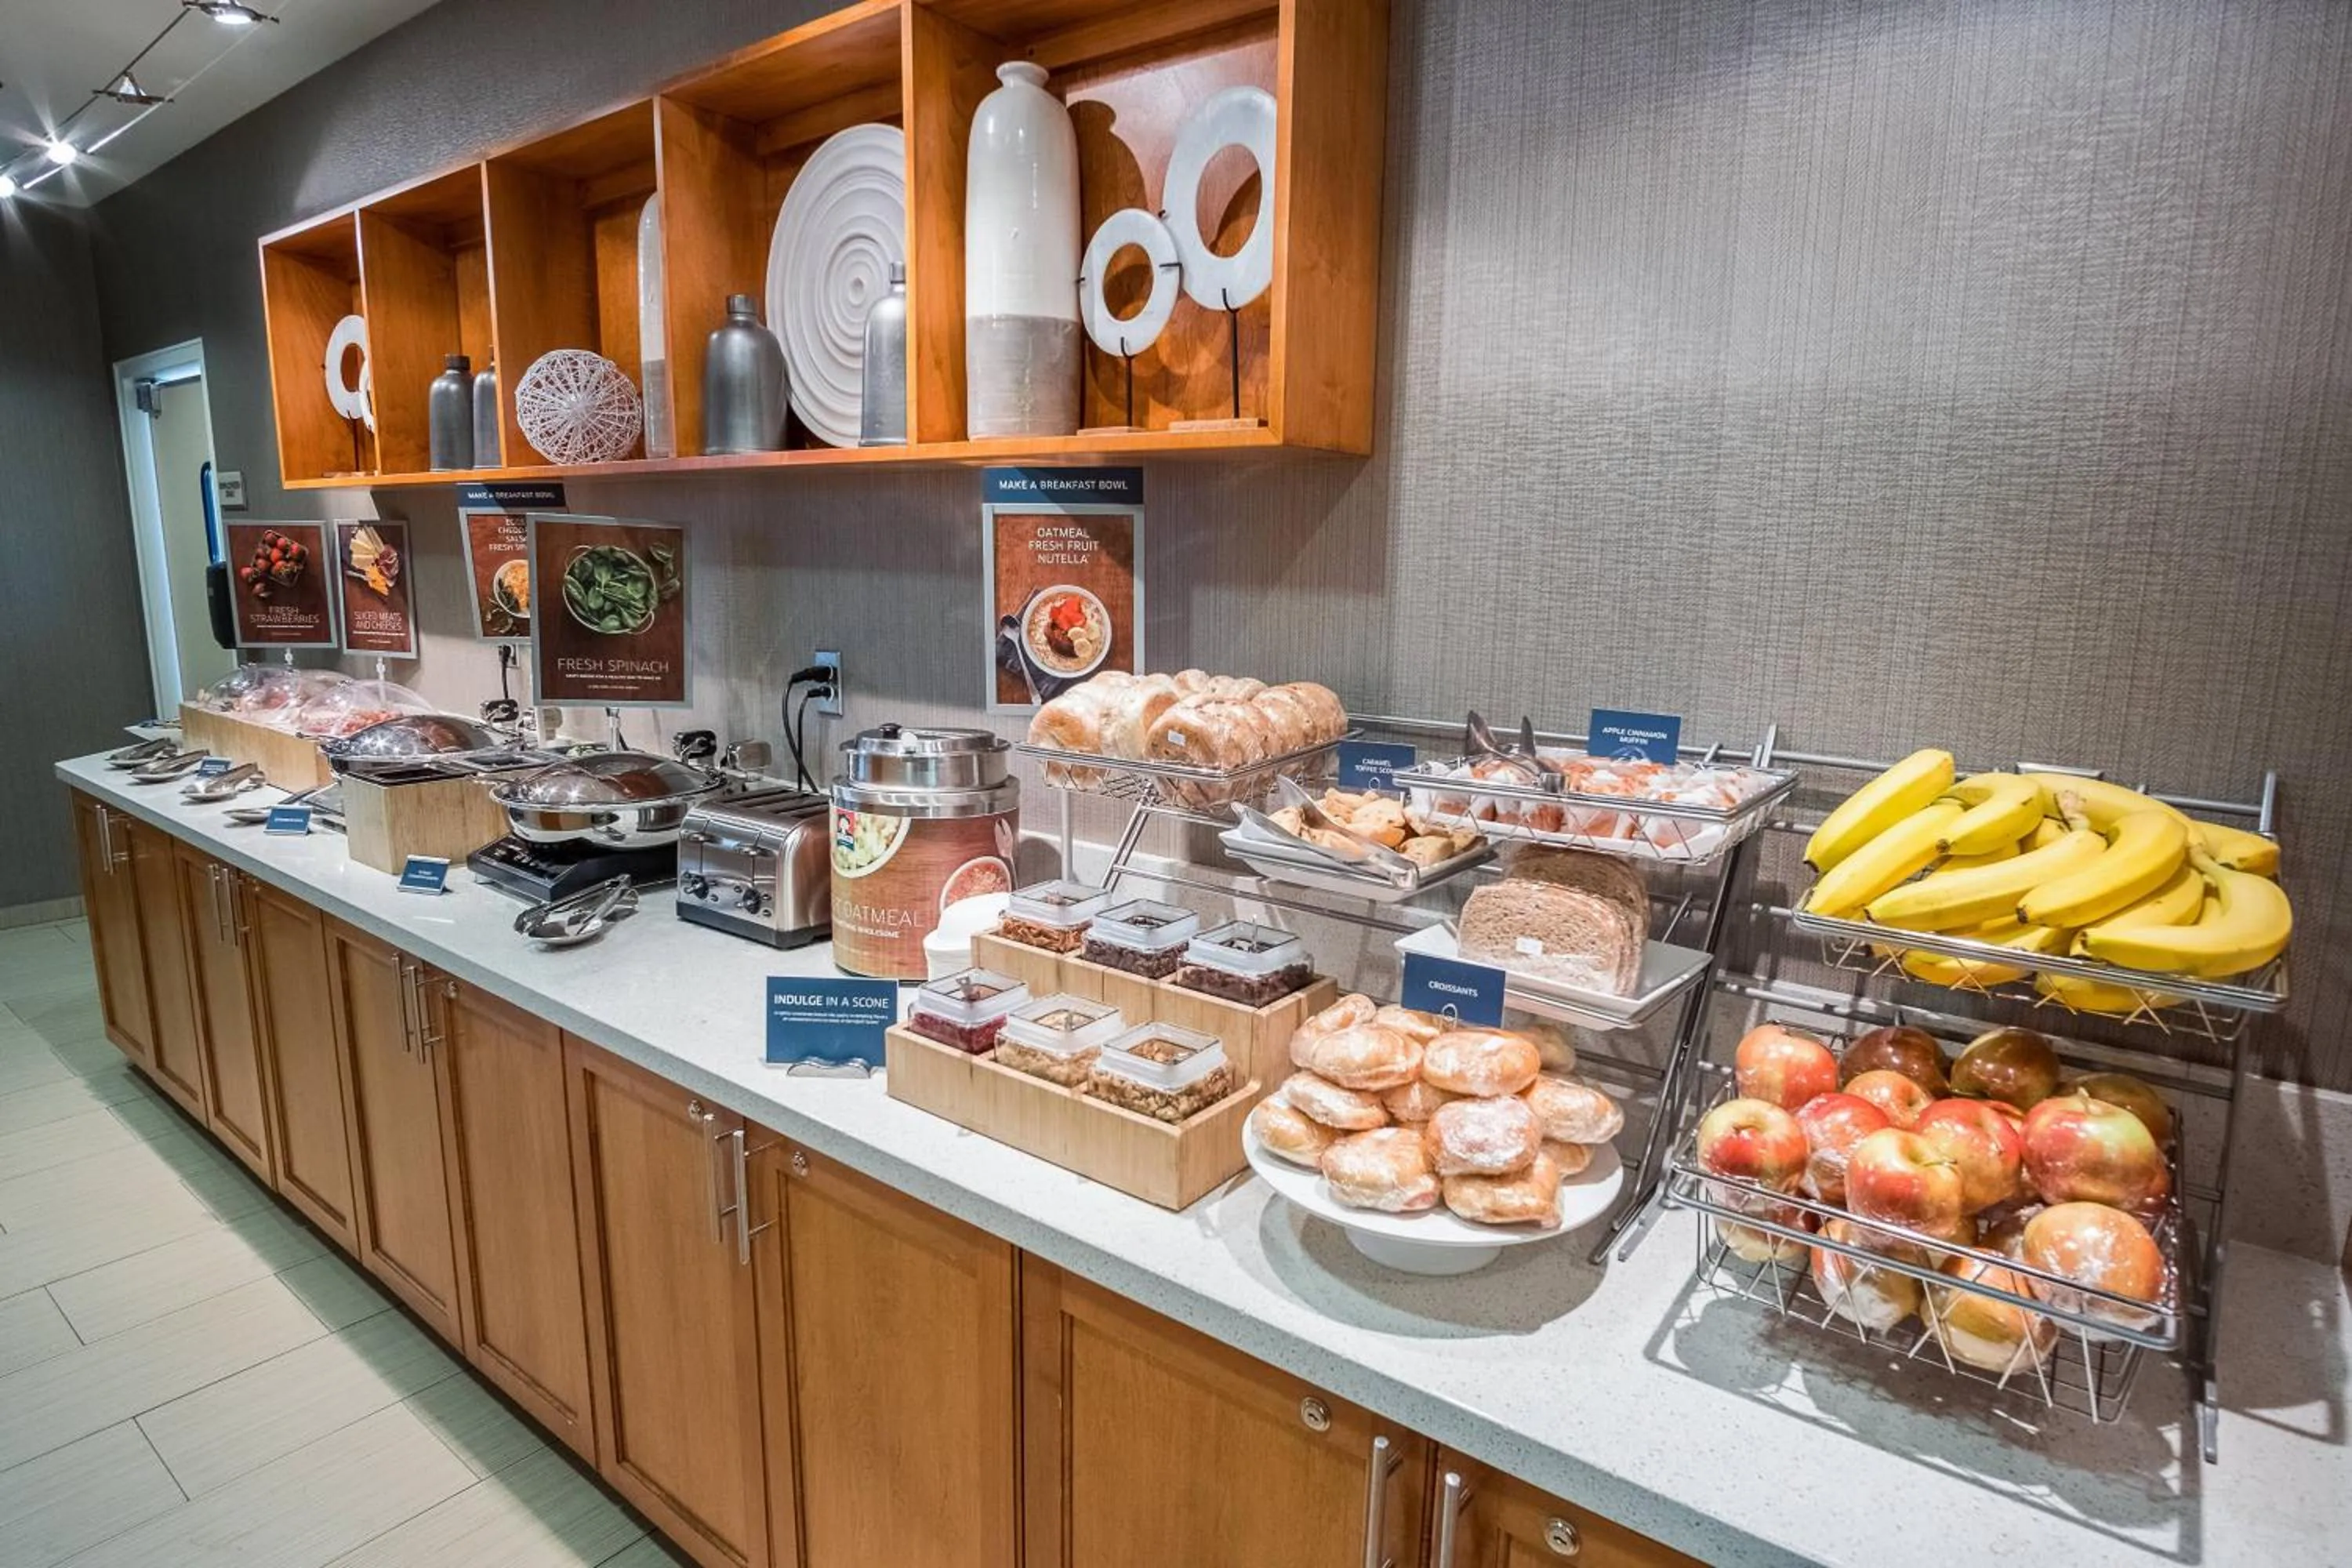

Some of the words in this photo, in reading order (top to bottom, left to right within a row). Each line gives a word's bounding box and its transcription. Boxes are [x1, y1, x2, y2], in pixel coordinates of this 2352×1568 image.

[999, 480, 1027, 490] MAKE
[1029, 481, 1037, 490] A
[1040, 480, 1096, 490] BREAKFAST
[1099, 481, 1128, 490] BOWL
[467, 491, 488, 499] MAKE
[1037, 528, 1090, 539] OATMEAL
[1029, 541, 1064, 551] FRESH
[1067, 541, 1099, 551] FRUIT
[269, 606, 299, 615] FRESH
[250, 614, 321, 623] STRAWBERRIES
[379, 612, 402, 622] MEATS
[557, 658, 603, 672] FRESH
[608, 659, 670, 673] SPINACH
[1627, 728, 1668, 740] CINNAMON
[1619, 736, 1649, 746] MUFFIN
[843, 901, 926, 928] OATMEAL
[1428, 980, 1478, 998] CROISSANTS
[774, 994, 822, 1006] INDULGE
[826, 996, 838, 1007] IN
[841, 997, 849, 1007] A
[852, 996, 890, 1009] SCONE
